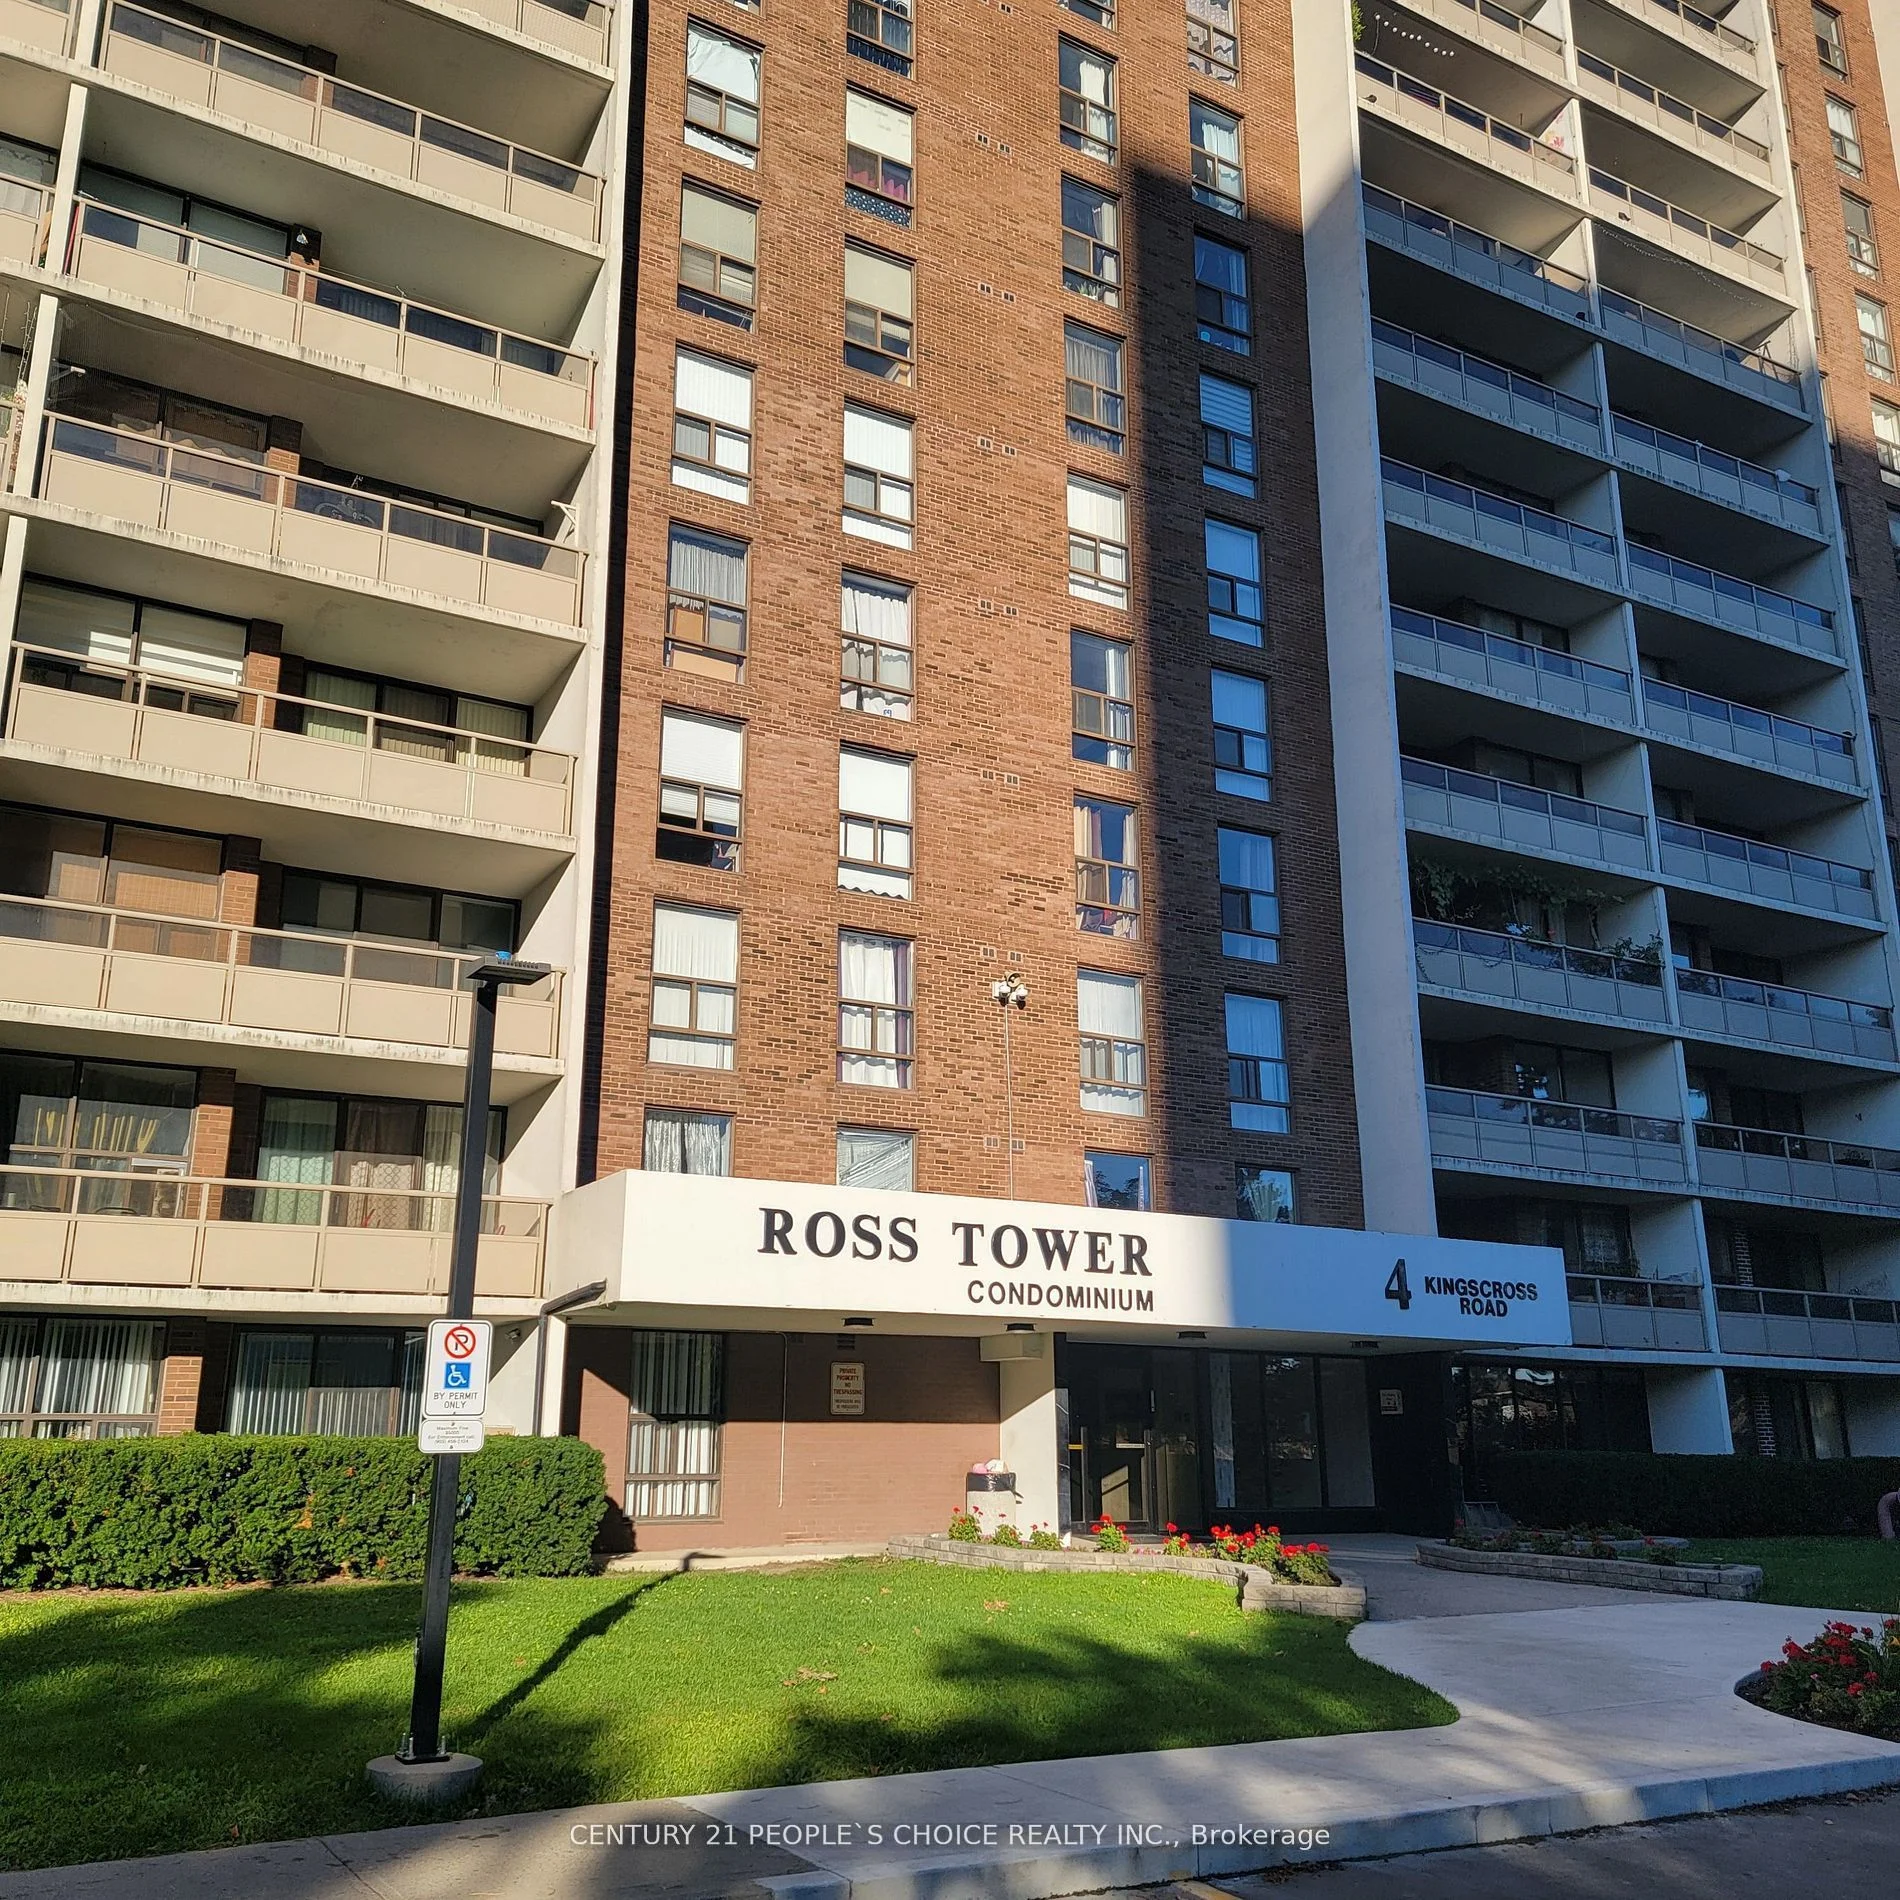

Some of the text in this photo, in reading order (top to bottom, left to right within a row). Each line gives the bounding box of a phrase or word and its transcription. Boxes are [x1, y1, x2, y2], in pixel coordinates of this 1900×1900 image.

[757, 1207, 1153, 1277] ROSS TOWER
[967, 1279, 1154, 1312] CONDOMINIUM
[1384, 1258, 1539, 1310] 4 KINGSCROSS
[1459, 1297, 1508, 1317] ROAD
